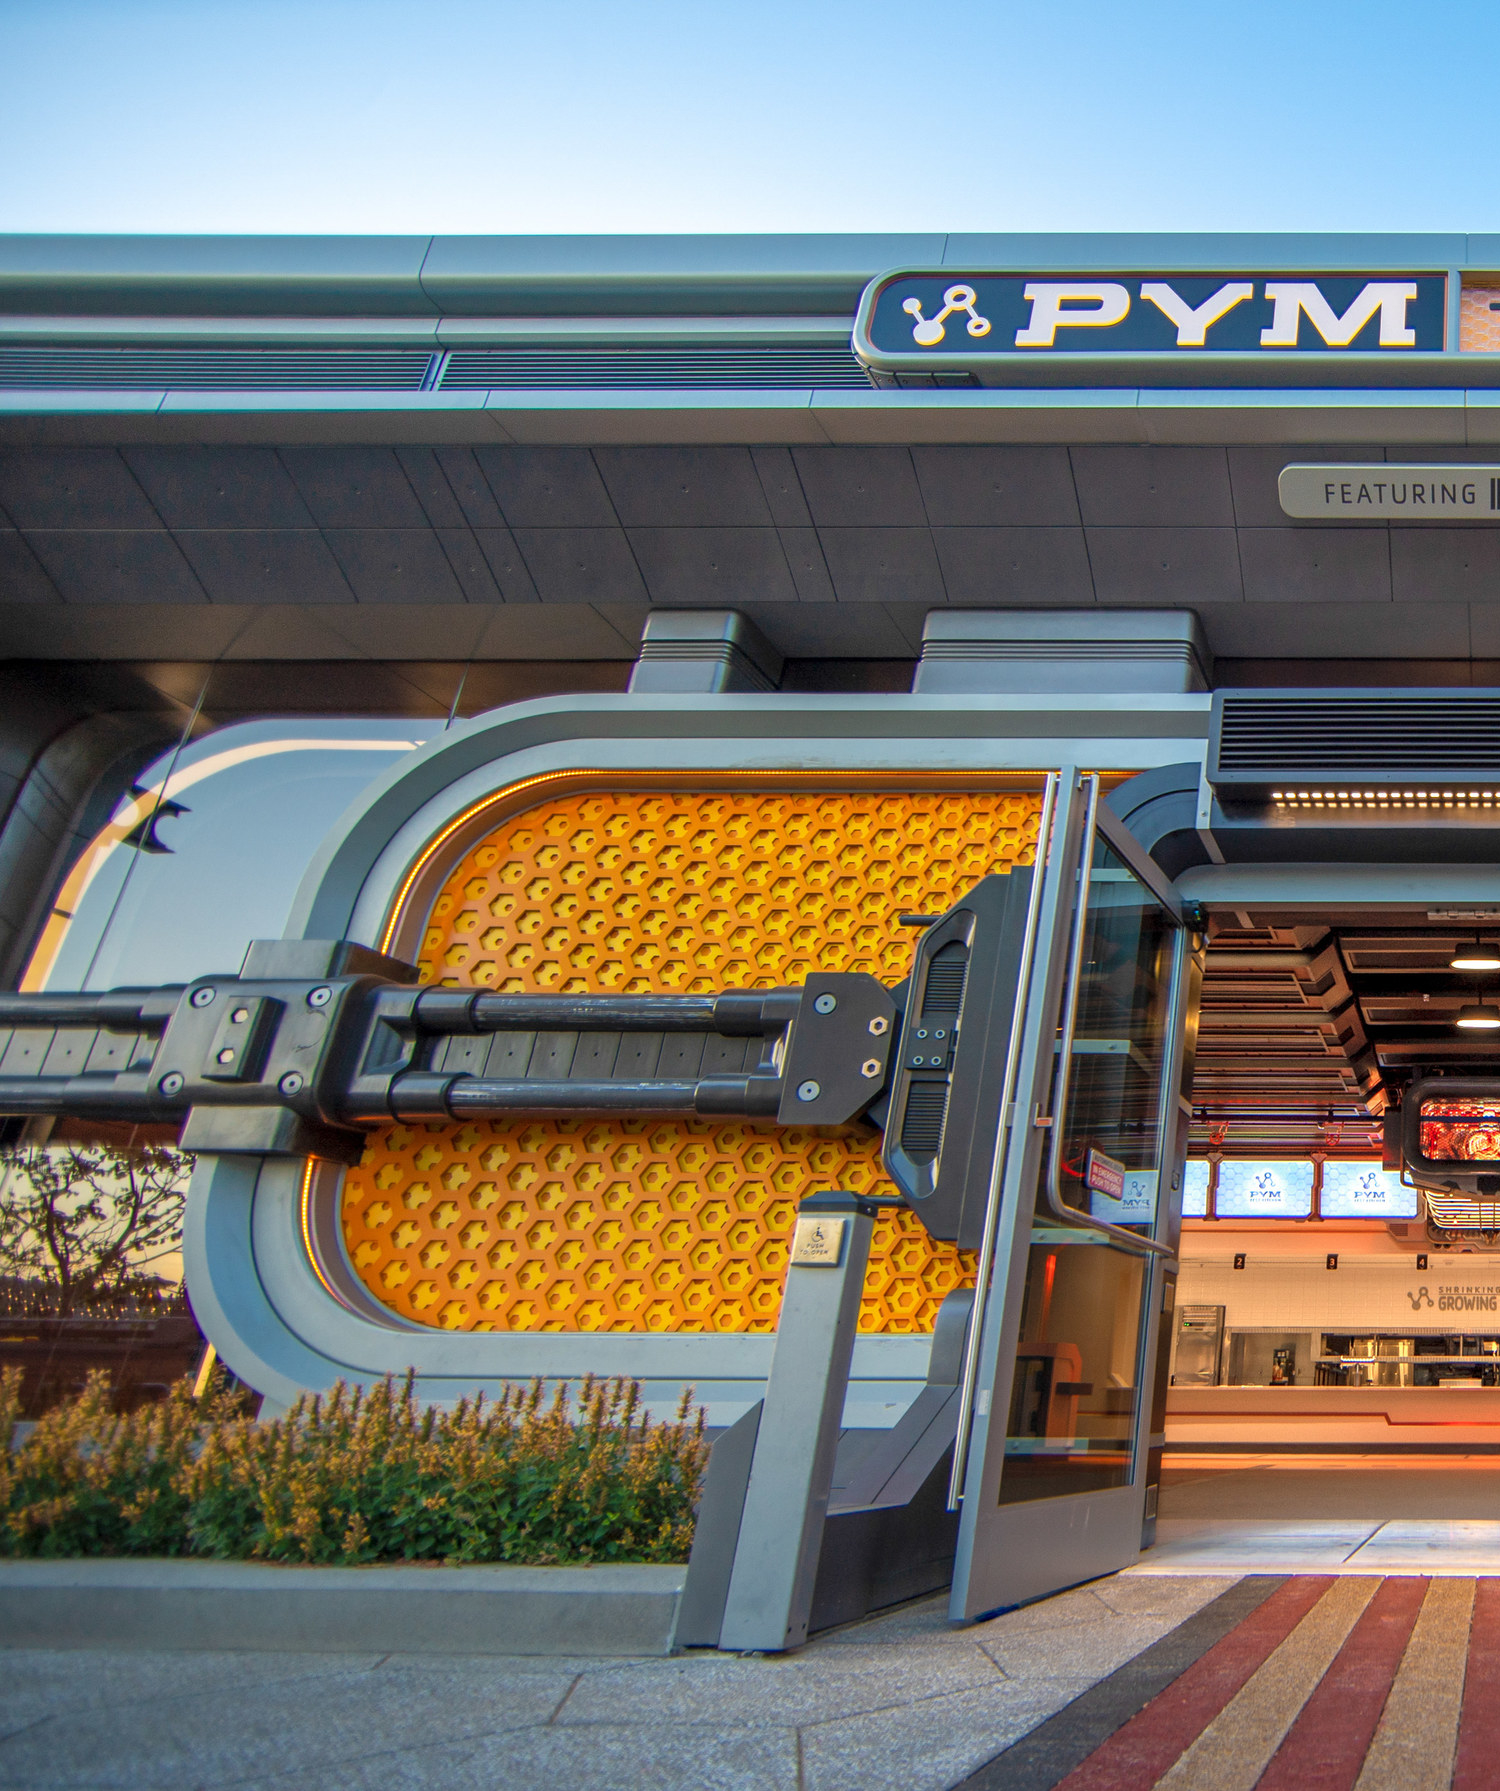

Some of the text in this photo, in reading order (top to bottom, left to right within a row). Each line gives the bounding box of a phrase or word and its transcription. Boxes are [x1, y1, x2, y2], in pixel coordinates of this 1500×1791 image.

[1015, 282, 1418, 347] PYM
[1324, 483, 1476, 505] FEATURING
[1438, 1296, 1497, 1311] GROWING
